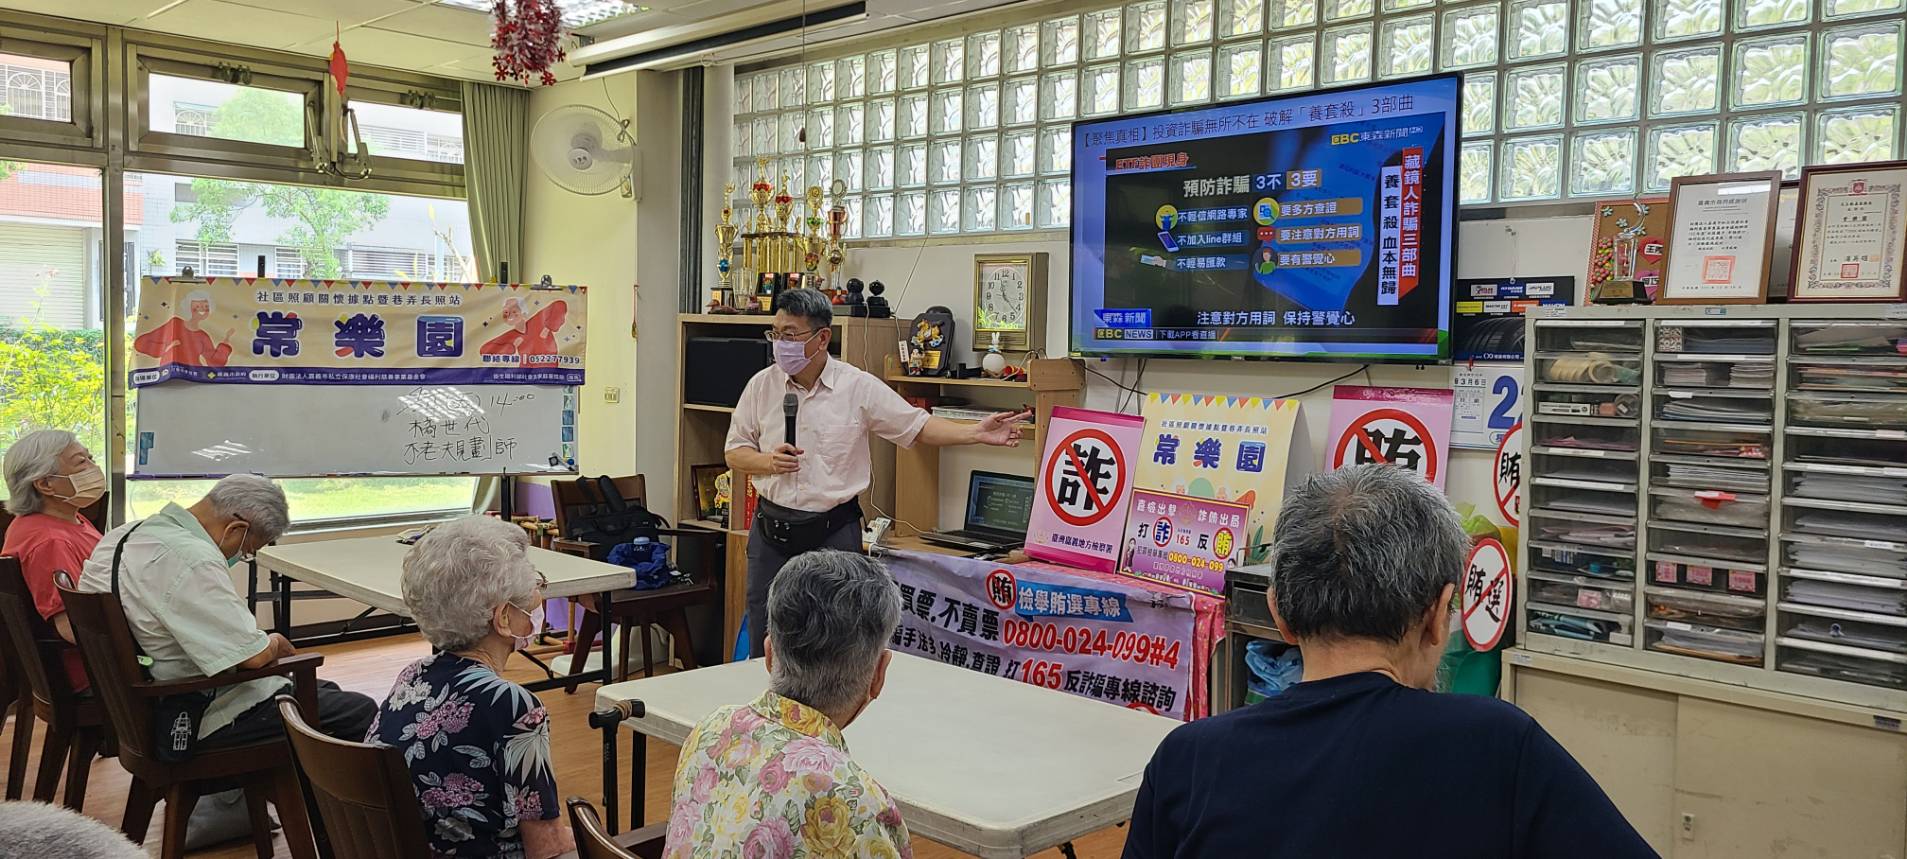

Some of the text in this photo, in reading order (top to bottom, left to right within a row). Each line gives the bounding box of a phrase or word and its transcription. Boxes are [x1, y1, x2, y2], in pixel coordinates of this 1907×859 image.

[1331, 133, 1360, 145] EBC
[1183, 175, 1250, 198] 預防詐騙
[1256, 173, 1282, 190] 3不
[1291, 170, 1318, 187] 3要
[1177, 208, 1248, 223] 不輕信網路專家
[1280, 202, 1337, 217] 要多方查證
[1401, 154, 1421, 278] 藏鏡人詐騙三部曲
[1177, 232, 1242, 246] 不加入line群組
[1280, 226, 1360, 241] 要注意對方用詞
[1380, 174, 1400, 295] 養套殺血本無歸
[1177, 256, 1226, 269] 不輕易匯款
[1279, 252, 1336, 267] 要有警覺心
[256, 290, 461, 306] 社區照顧關懷據點暨巷弄長照站
[1102, 311, 1146, 324] 東森新聞
[1196, 310, 1355, 326] 注意對方用詞 保持警覺心
[251, 310, 464, 358] 常樂園
[1097, 329, 1122, 339] EBC
[1125, 330, 1152, 339] NEWS
[530, 355, 580, 365] 052277939
[1488, 375, 1523, 429] 2
[408, 416, 490, 438] 橘世代
[1152, 433, 1266, 473] 常樂園
[1057, 442, 1117, 512] 詐
[1176, 534, 1191, 546] 165
[1168, 551, 1225, 572] 0800-024-099
[1018, 586, 1121, 618] 檢舉賄選專線
[1003, 618, 1182, 670] 0800-024-099#4
[1021, 658, 1064, 691] 165
[1064, 669, 1178, 713] 反詐騙專線諮詢
